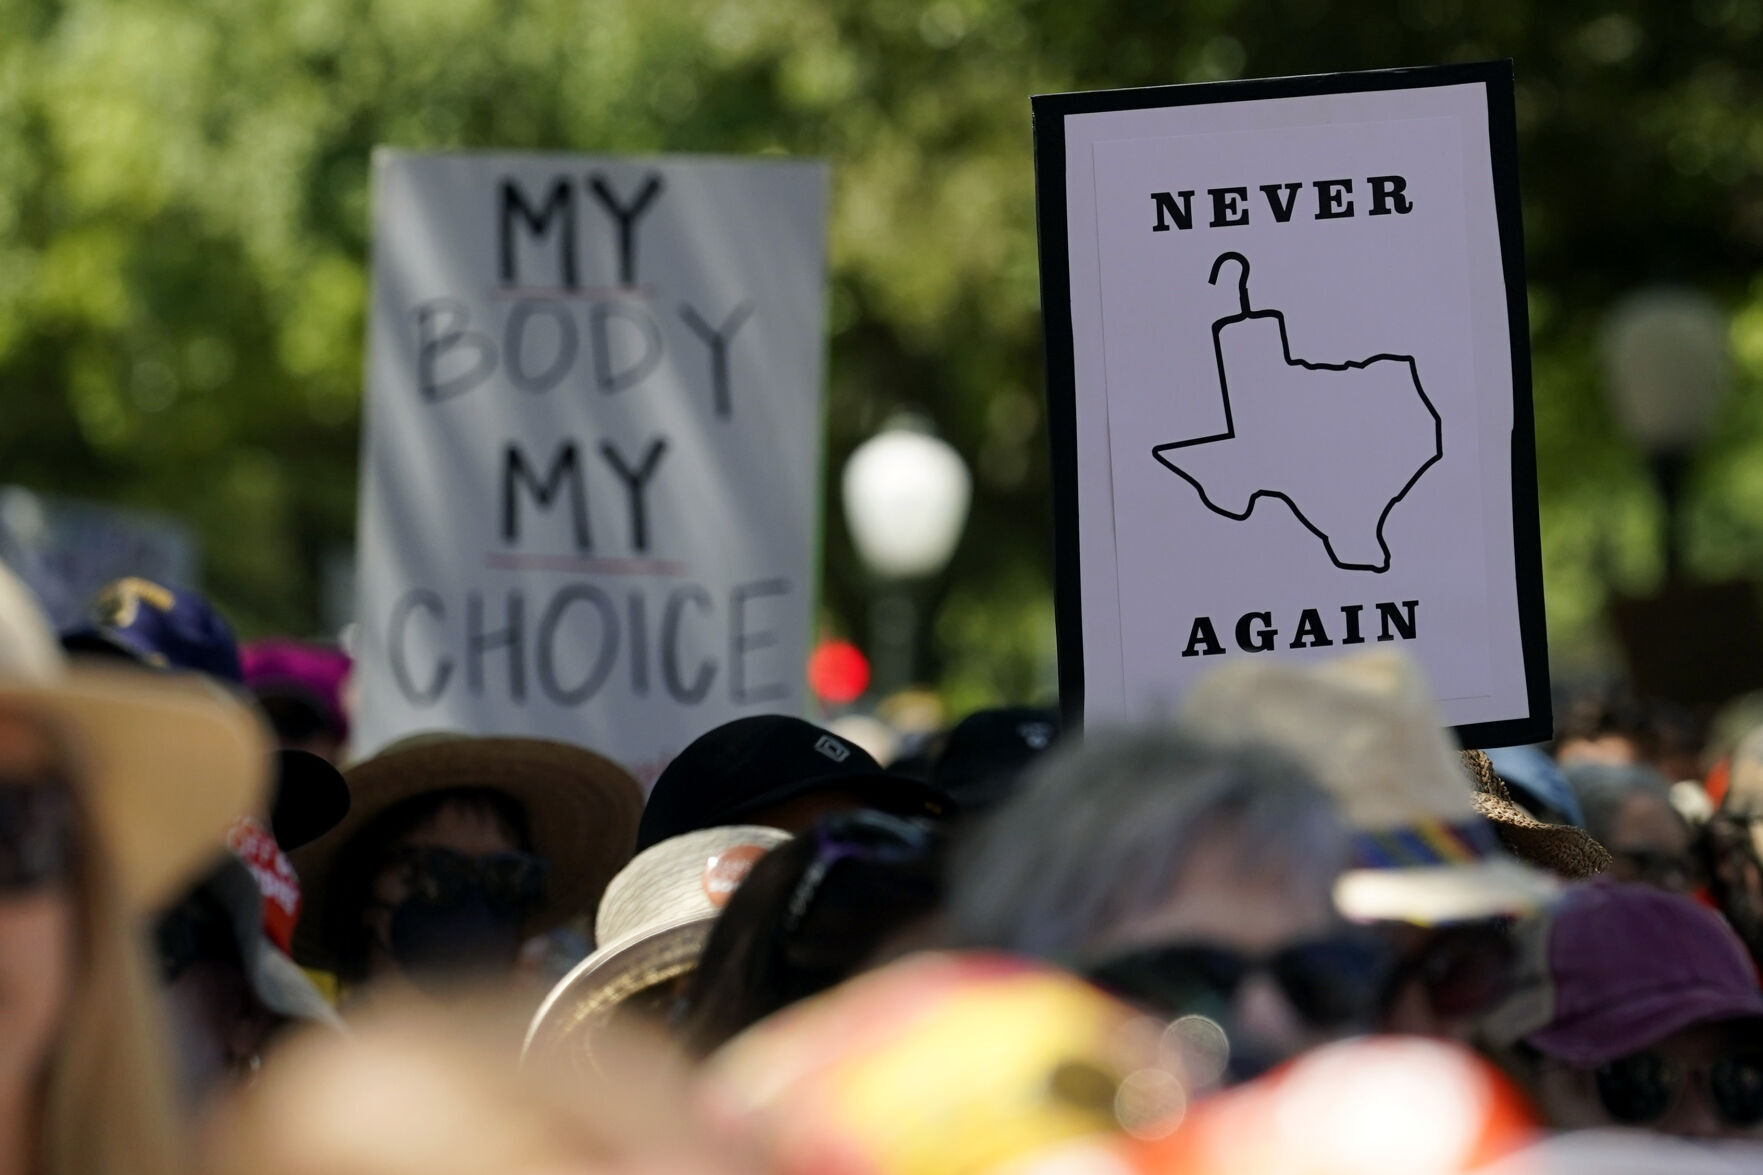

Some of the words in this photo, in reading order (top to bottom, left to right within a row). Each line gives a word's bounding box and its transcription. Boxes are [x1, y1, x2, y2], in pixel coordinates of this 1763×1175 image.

[497, 174, 665, 292] MY
[1151, 175, 1414, 232] NEVER
[414, 297, 755, 420] BODY
[502, 437, 669, 554] MY
[387, 577, 795, 709] CHOICE
[1181, 600, 1420, 657] AGAIN
